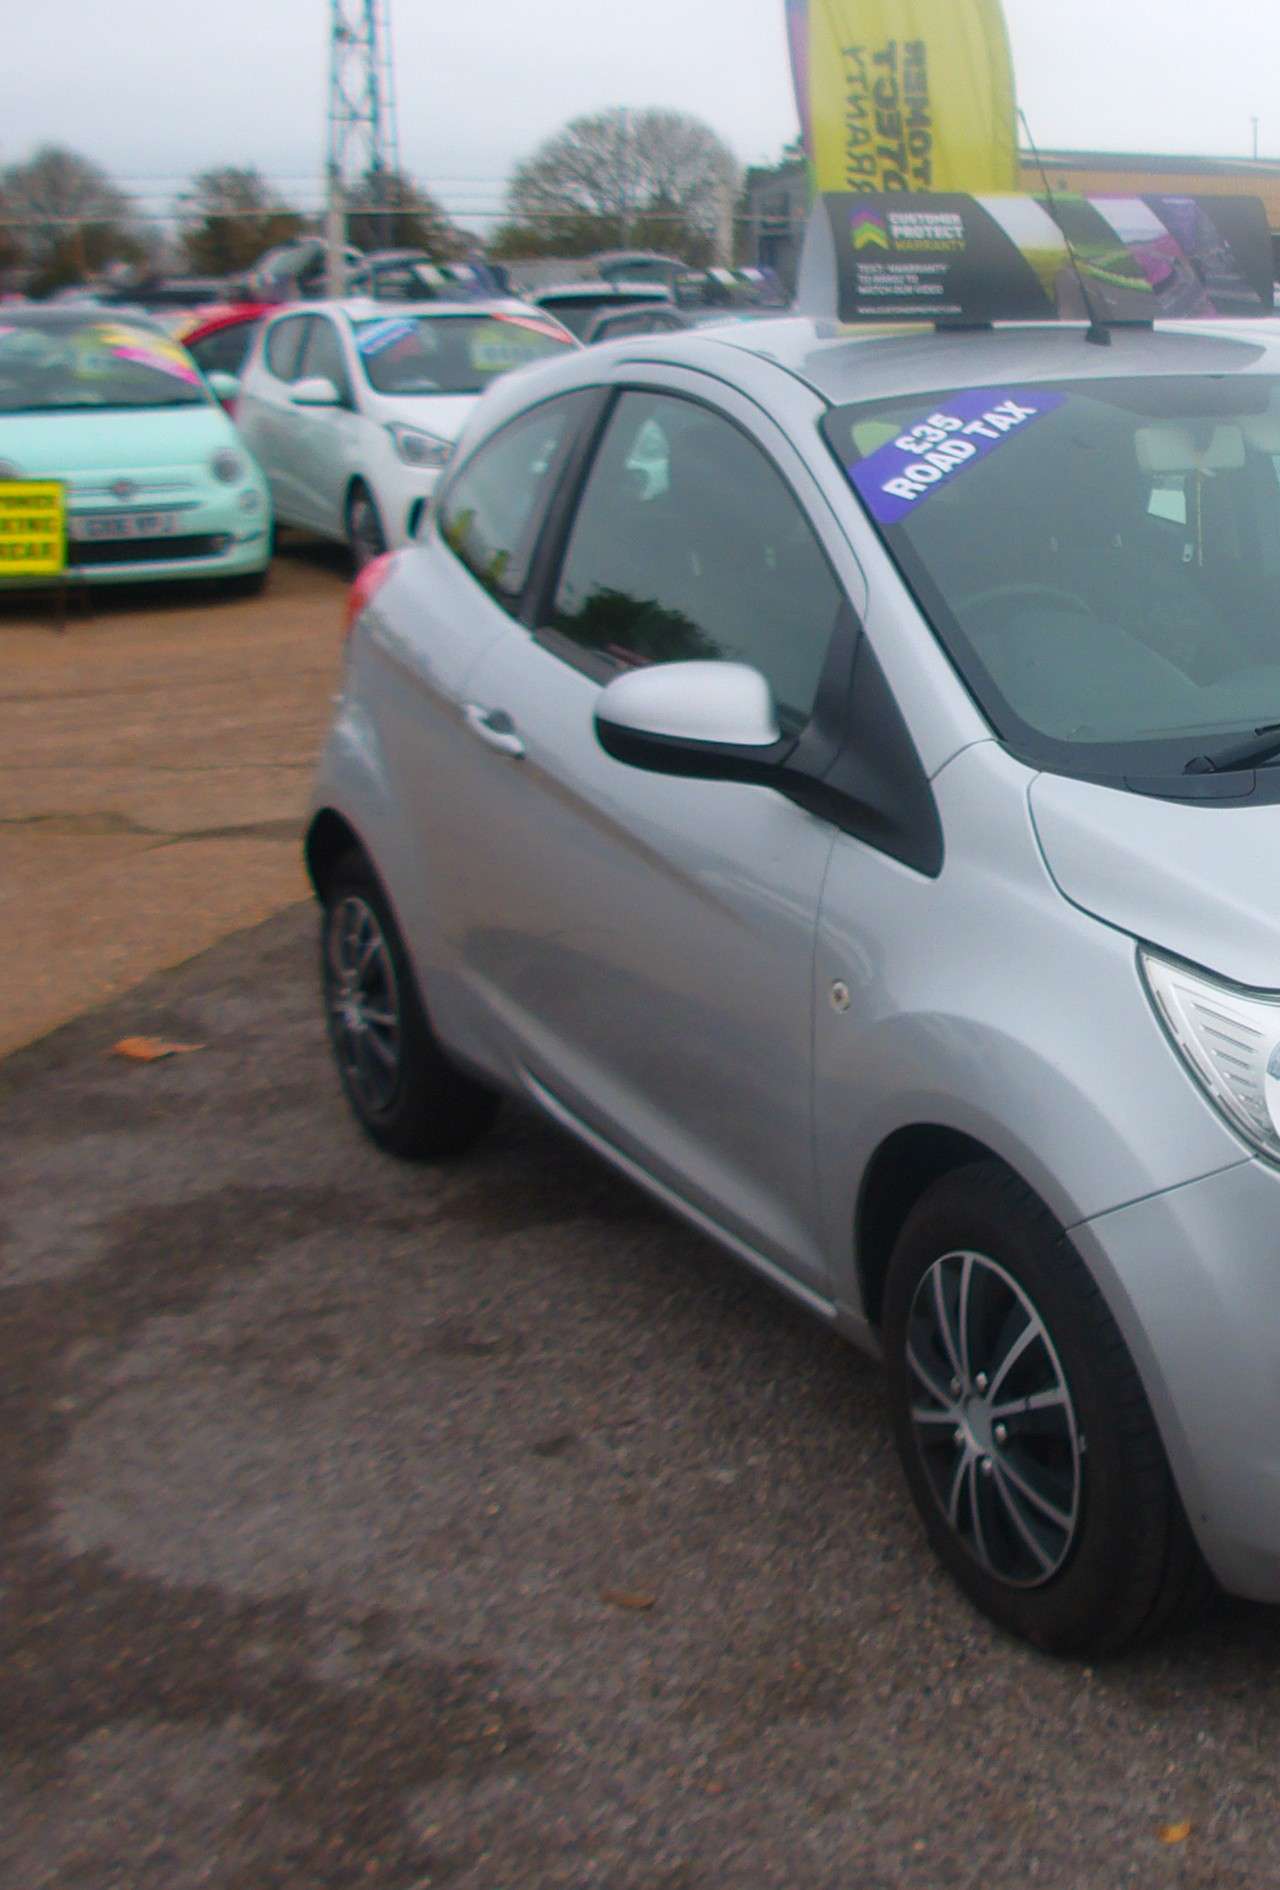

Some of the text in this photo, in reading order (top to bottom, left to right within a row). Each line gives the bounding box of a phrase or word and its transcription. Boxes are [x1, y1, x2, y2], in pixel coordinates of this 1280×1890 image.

[892, 224, 964, 240] PROTECT
[881, 400, 1037, 500] ROAD TAX
[895, 413, 964, 455] £35
